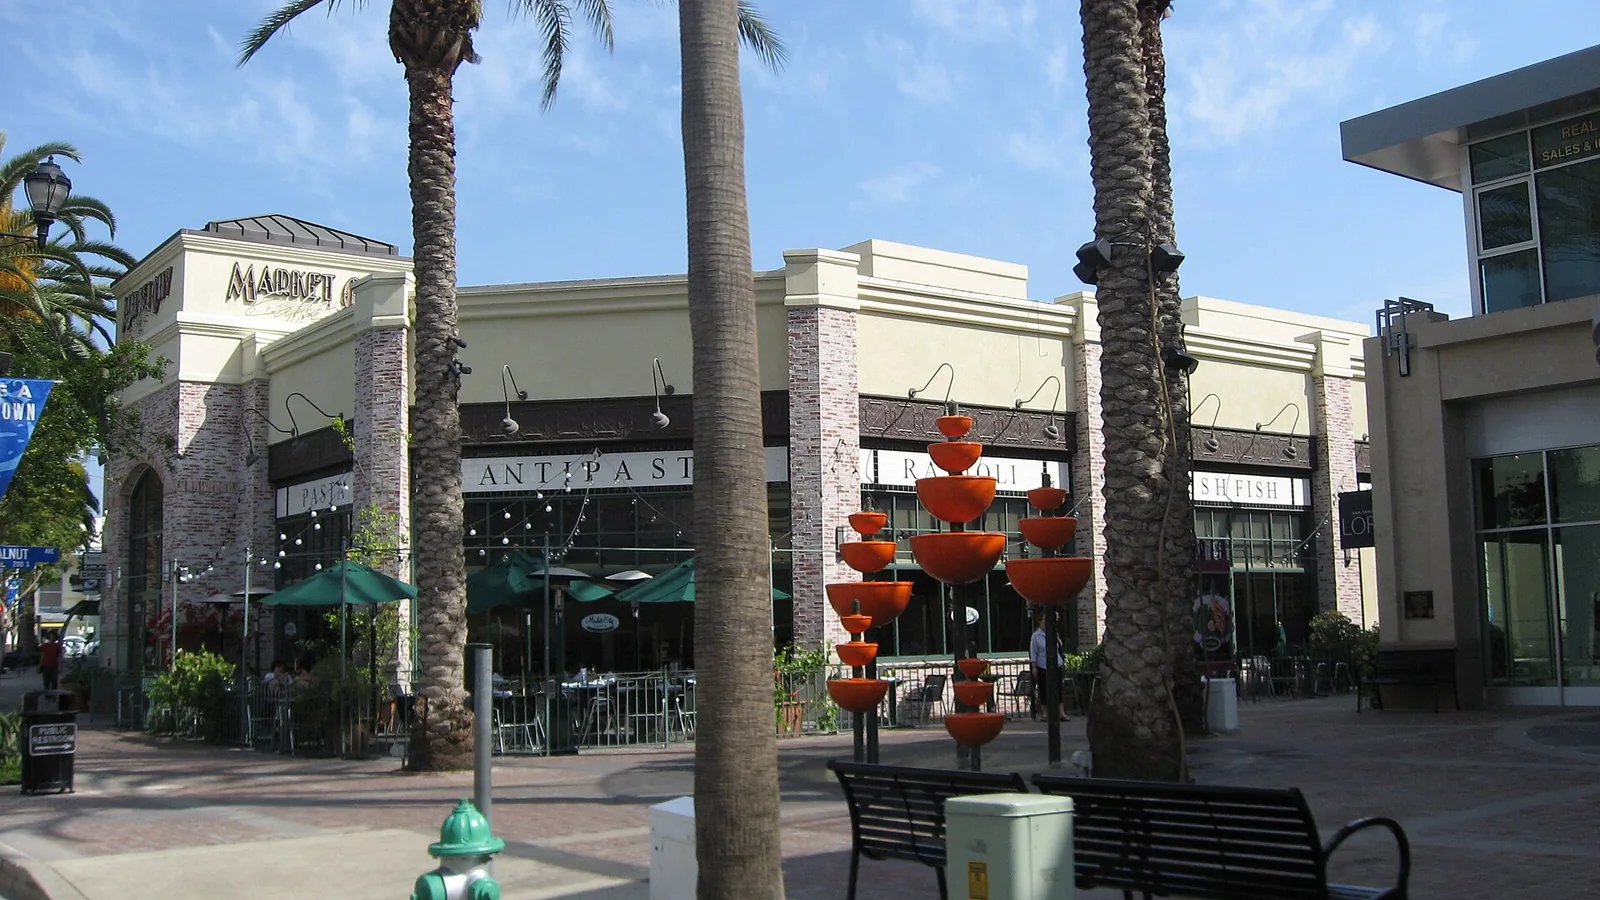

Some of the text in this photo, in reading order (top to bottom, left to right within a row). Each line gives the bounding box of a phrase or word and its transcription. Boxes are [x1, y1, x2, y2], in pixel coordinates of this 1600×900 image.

[1561, 120, 1598, 139] REAL
[1542, 143, 1581, 161] SALES
[1583, 141, 1592, 152] &
[225, 261, 336, 307] MARKET
[0, 402, 36, 421] OWN
[904, 458, 1016, 485] RAOLI
[1235, 479, 1278, 500] FISH
